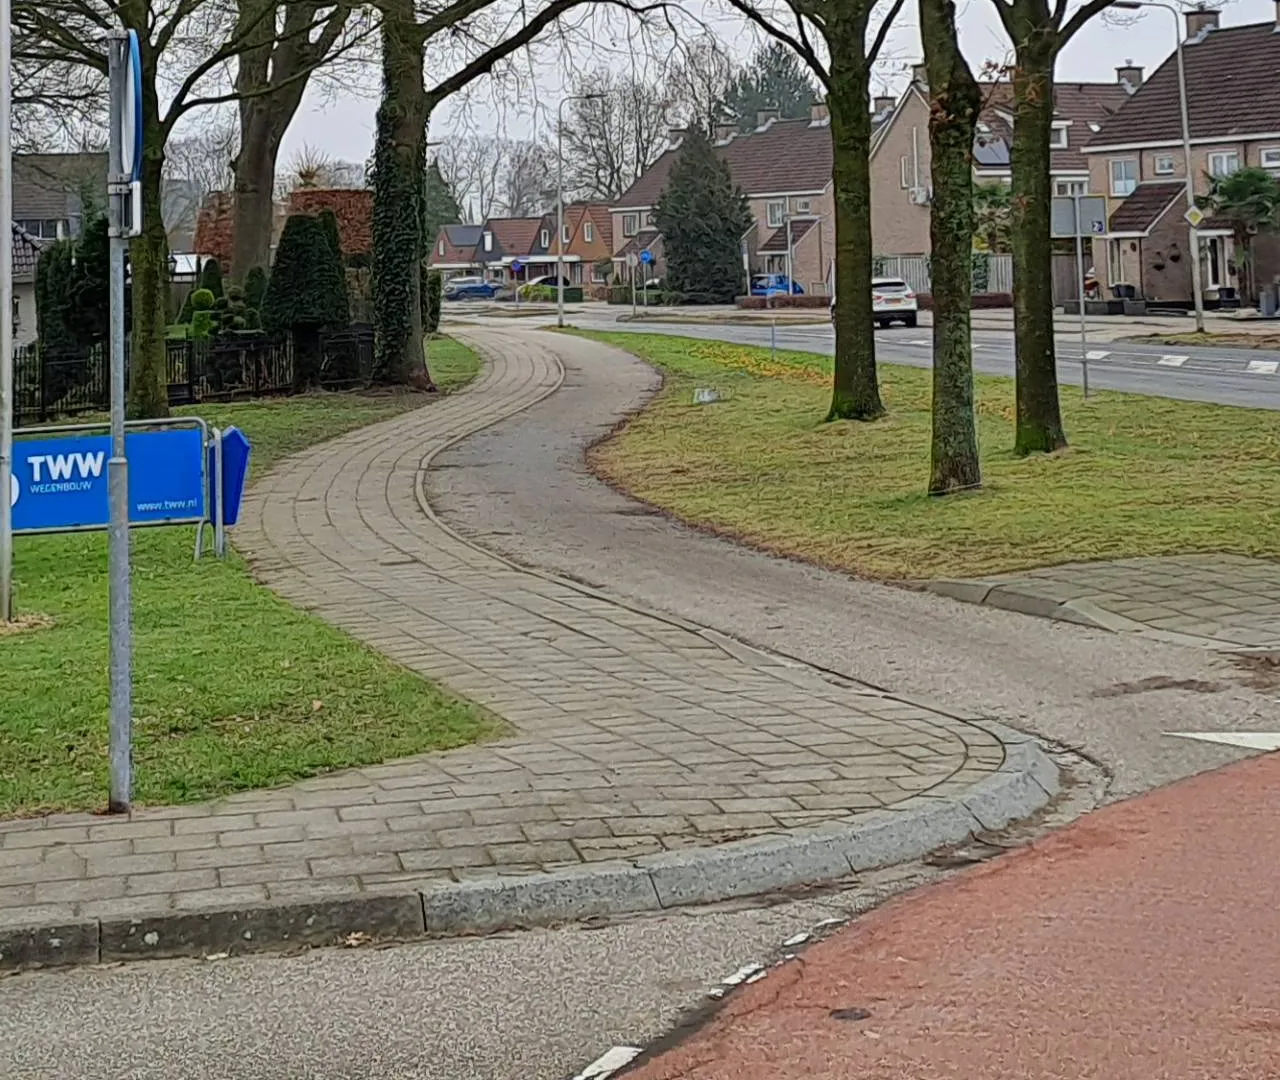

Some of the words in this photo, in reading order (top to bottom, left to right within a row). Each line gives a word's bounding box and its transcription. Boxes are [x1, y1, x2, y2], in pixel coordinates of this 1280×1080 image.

[28, 451, 105, 482] TWW
[30, 481, 92, 494] WEGENBOUW
[136, 497, 198, 512] www.tww.nl
